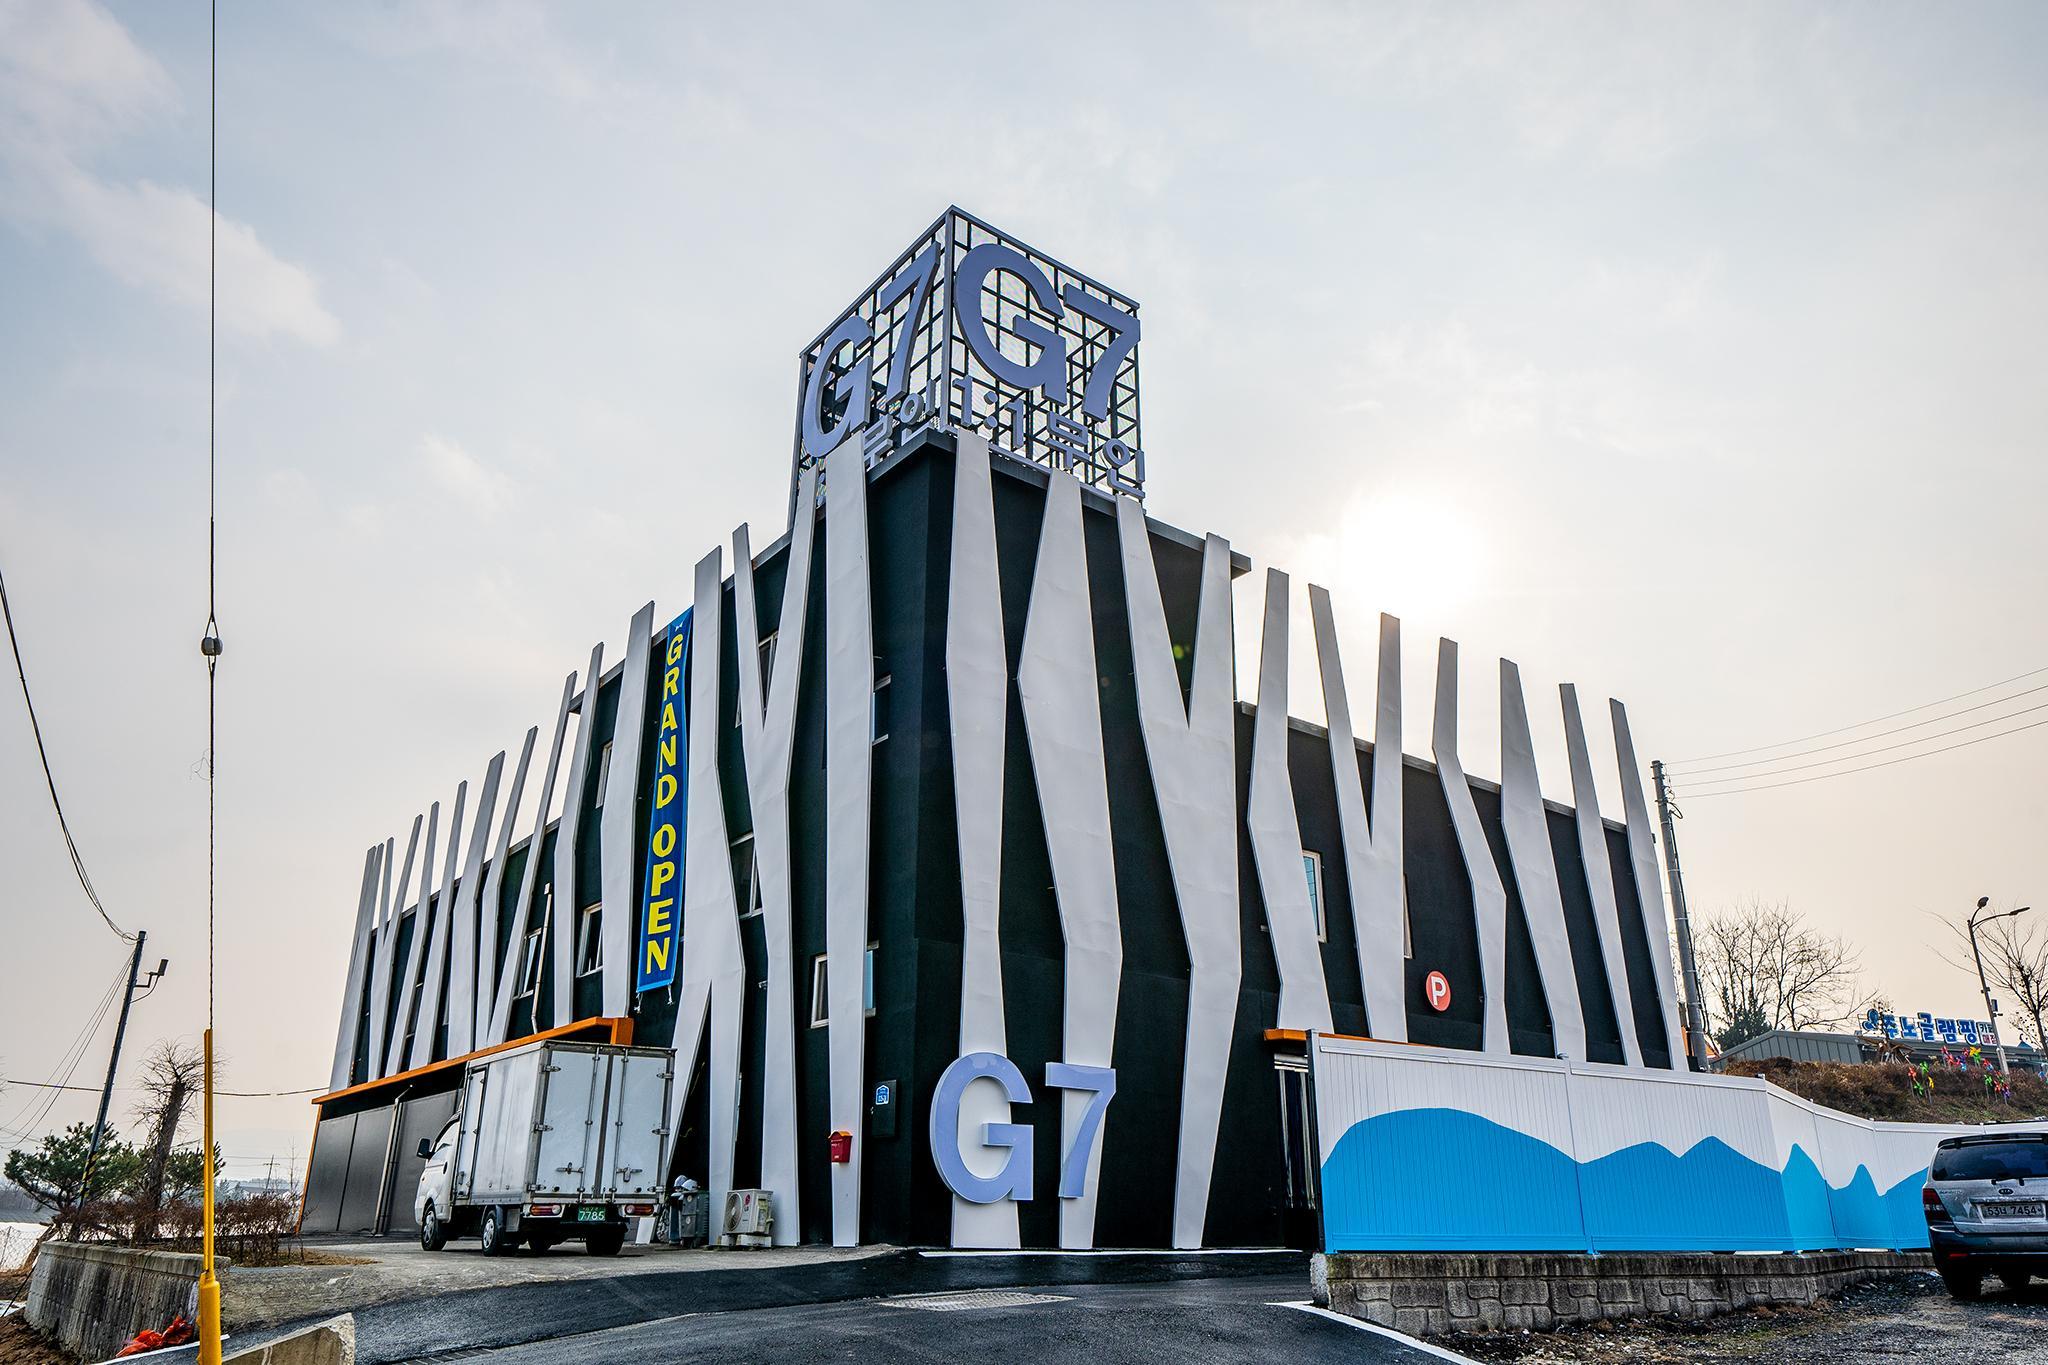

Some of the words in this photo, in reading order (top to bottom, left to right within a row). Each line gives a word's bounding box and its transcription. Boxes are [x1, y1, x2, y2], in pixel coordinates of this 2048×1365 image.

[803, 241, 942, 457] G7
[955, 243, 1141, 423] G7
[952, 375, 1025, 449] 1:1
[1045, 411, 1146, 499] 무인
[656, 633, 684, 809] GRAND
[646, 823, 677, 975] OPEN
[1431, 976, 1447, 1005] P
[930, 1052, 1117, 1204] G7
[579, 1210, 605, 1221] 7785
[2010, 1206, 2037, 1215] 7454
